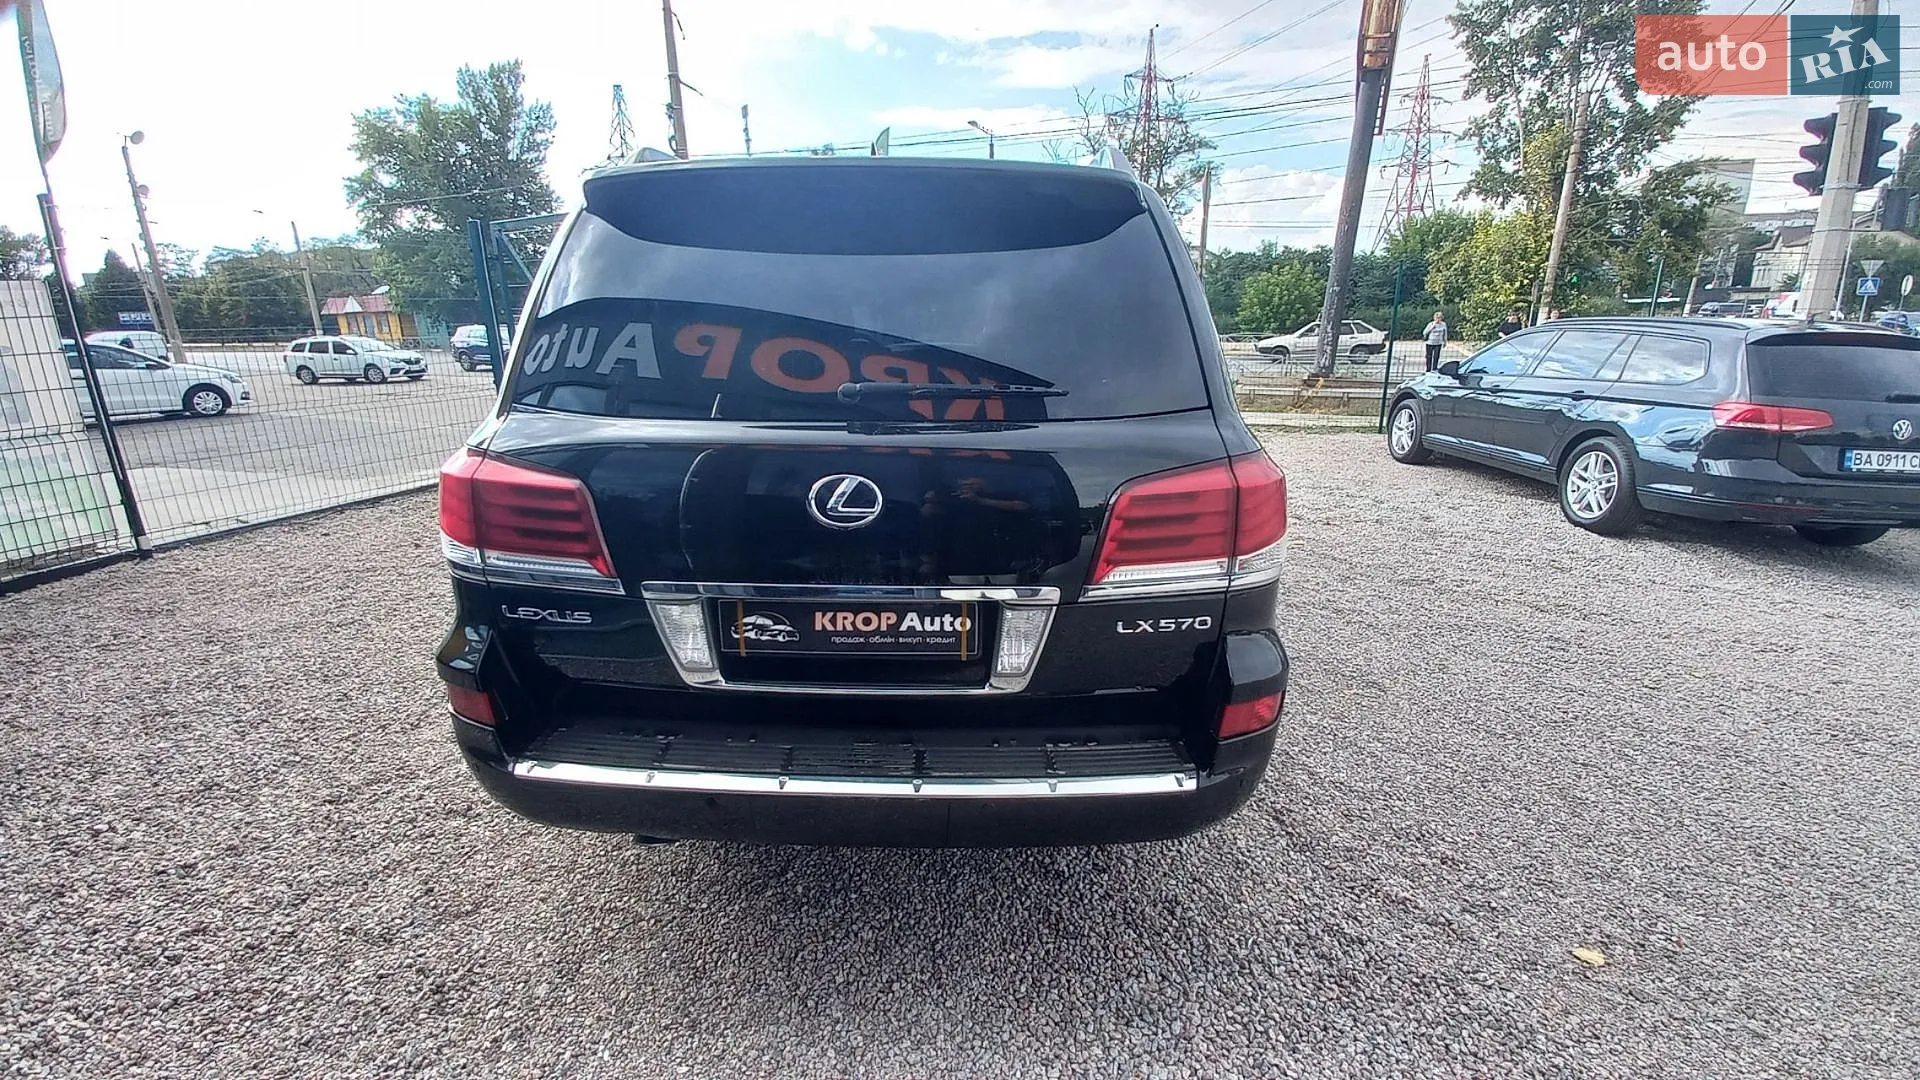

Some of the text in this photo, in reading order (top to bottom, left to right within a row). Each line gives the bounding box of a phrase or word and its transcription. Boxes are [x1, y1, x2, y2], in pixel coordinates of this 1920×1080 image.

[1853, 452, 1920, 469] BA 0911 C
[501, 604, 592, 624] LEXUS
[814, 611, 972, 632] KROP Auto
